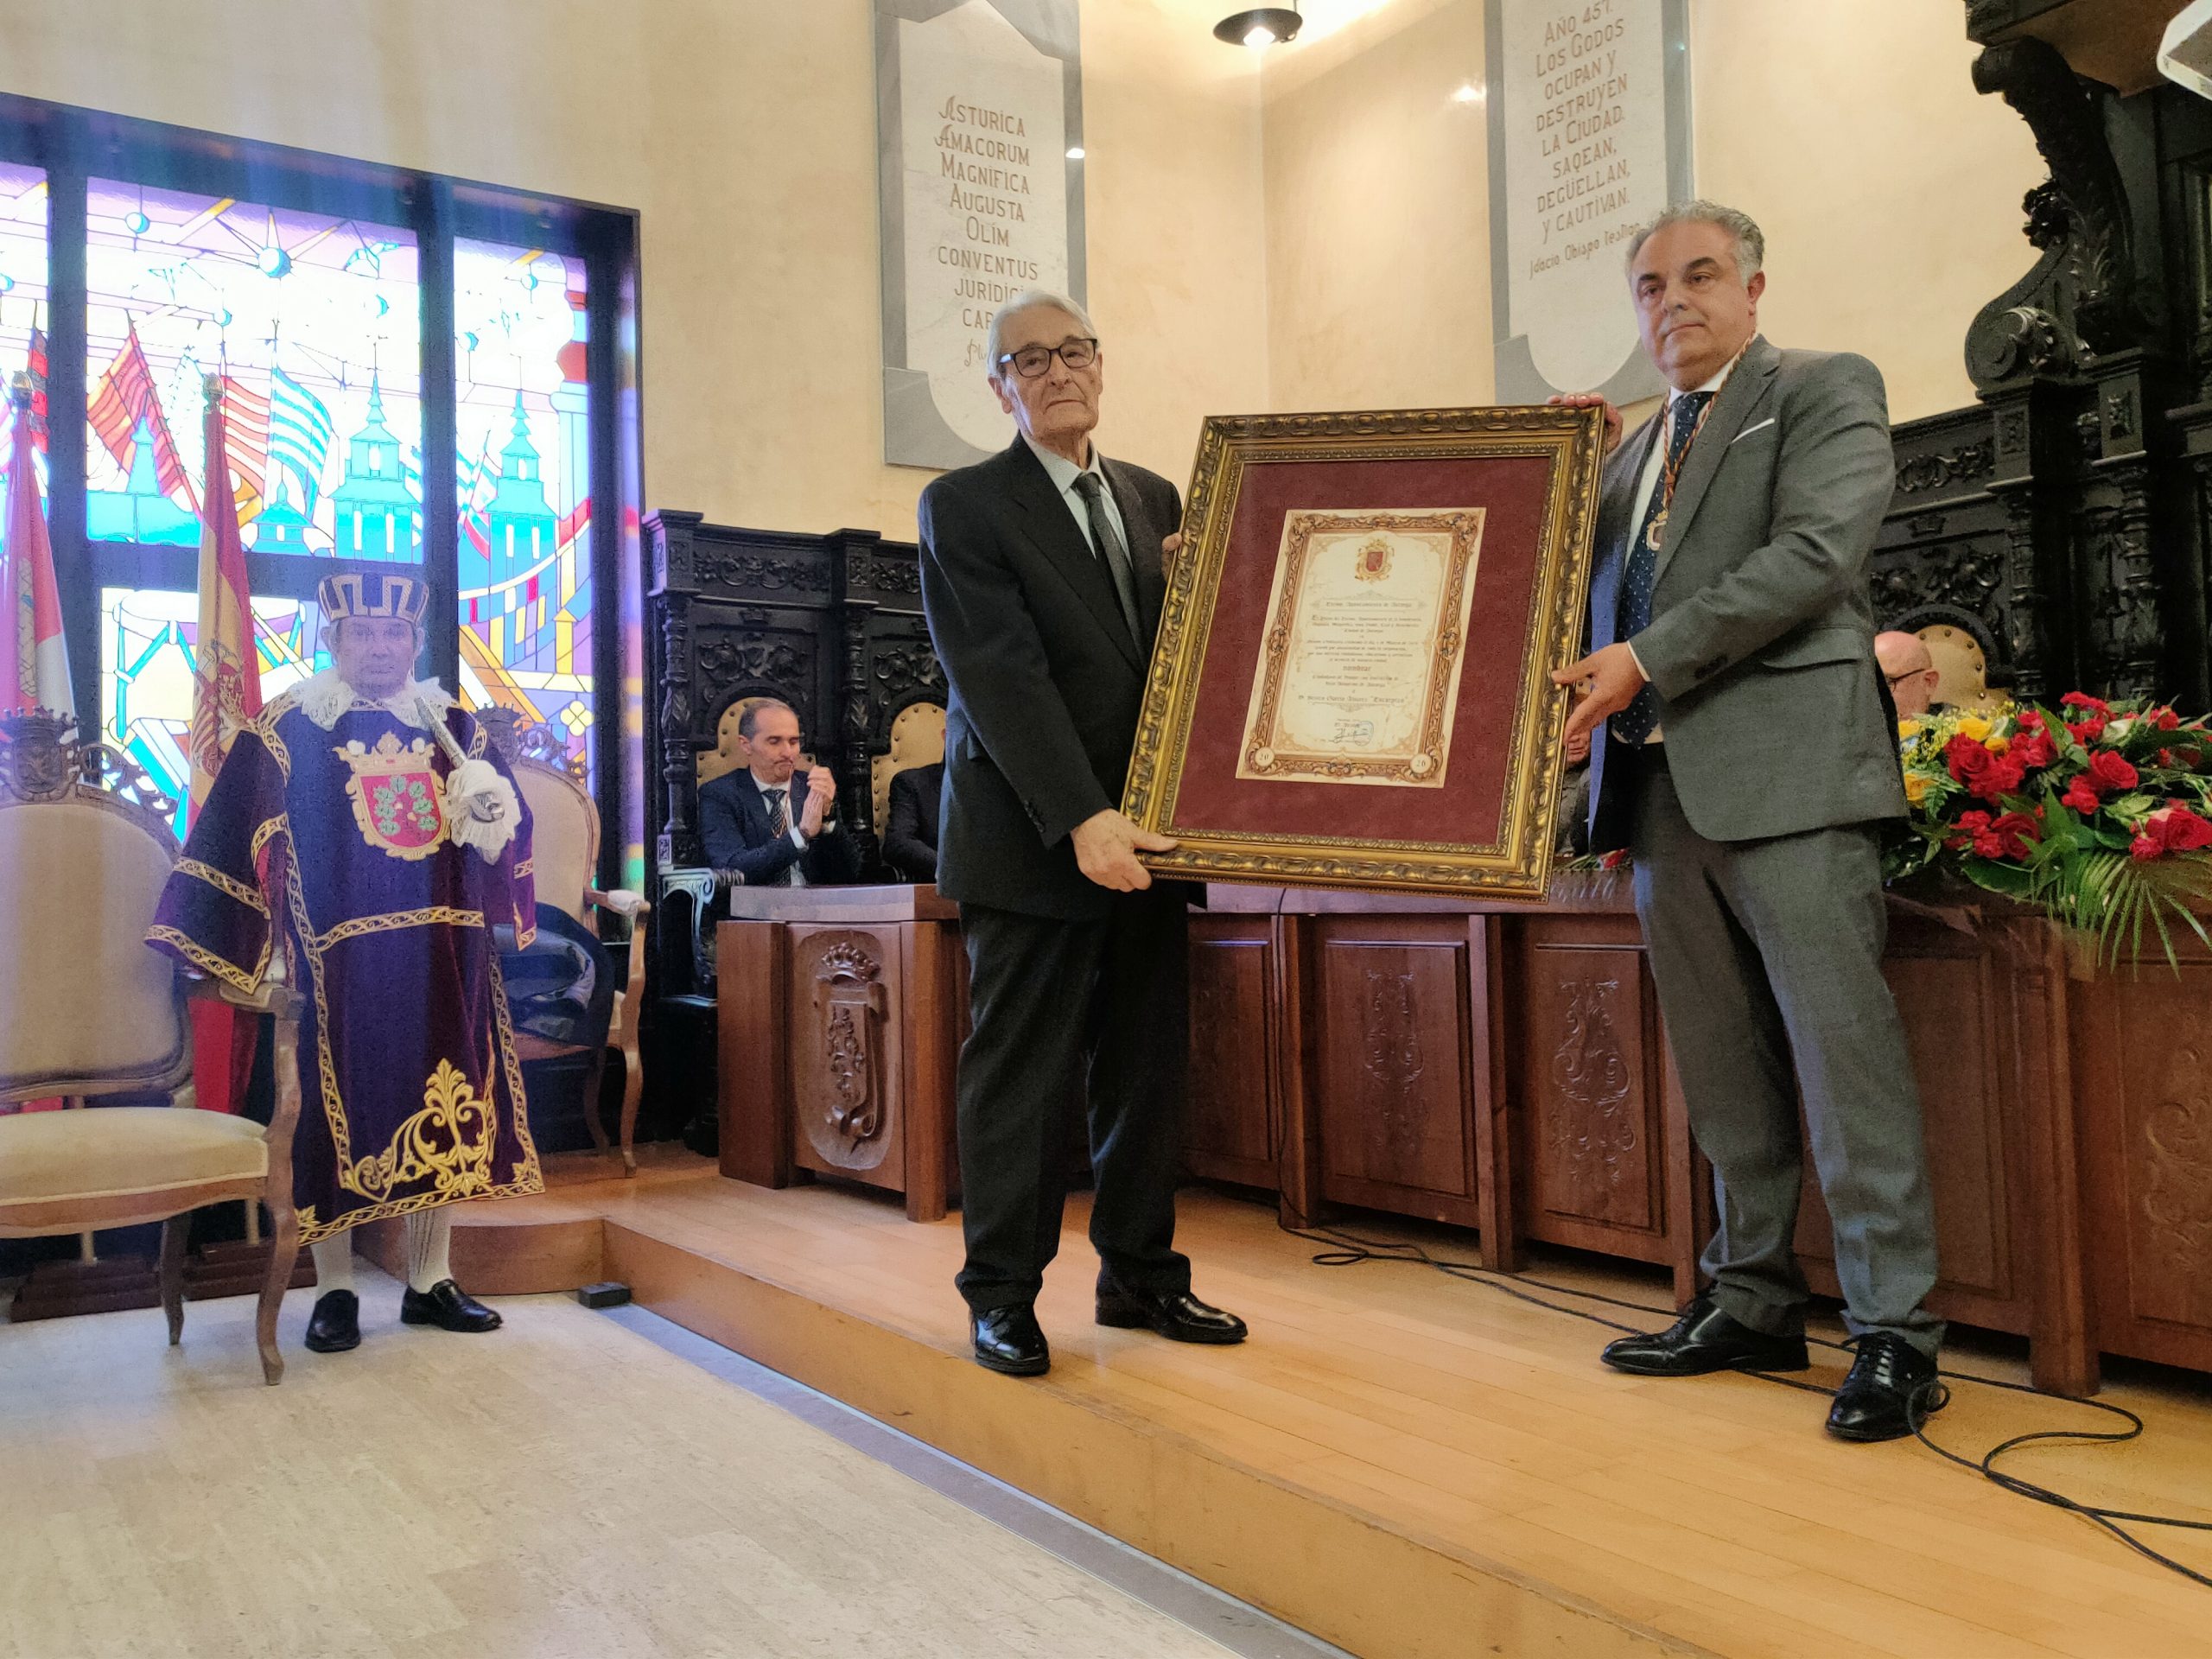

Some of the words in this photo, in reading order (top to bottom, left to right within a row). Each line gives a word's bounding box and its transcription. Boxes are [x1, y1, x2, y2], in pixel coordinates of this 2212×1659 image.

[1536, 48, 1567, 79] LOS
[1571, 17, 1624, 58] GODOS
[1543, 16, 1576, 48] AÑO
[1544, 56, 1602, 100] OCUPAN
[1606, 49, 1617, 78] Y
[938, 95, 1026, 137] ASTURICA
[1536, 73, 1628, 133] DESTRUYEN
[934, 124, 1030, 167] AMACORUM
[1541, 134, 1561, 157] LA
[940, 151, 1031, 194] MAGNIFICA
[950, 182, 1026, 222] AUGUSTA
[966, 215, 1010, 247] OLIM
[1541, 219, 1551, 245] Y
[938, 245, 1039, 281] CONVENTUS
[962, 308, 995, 330] CAP
